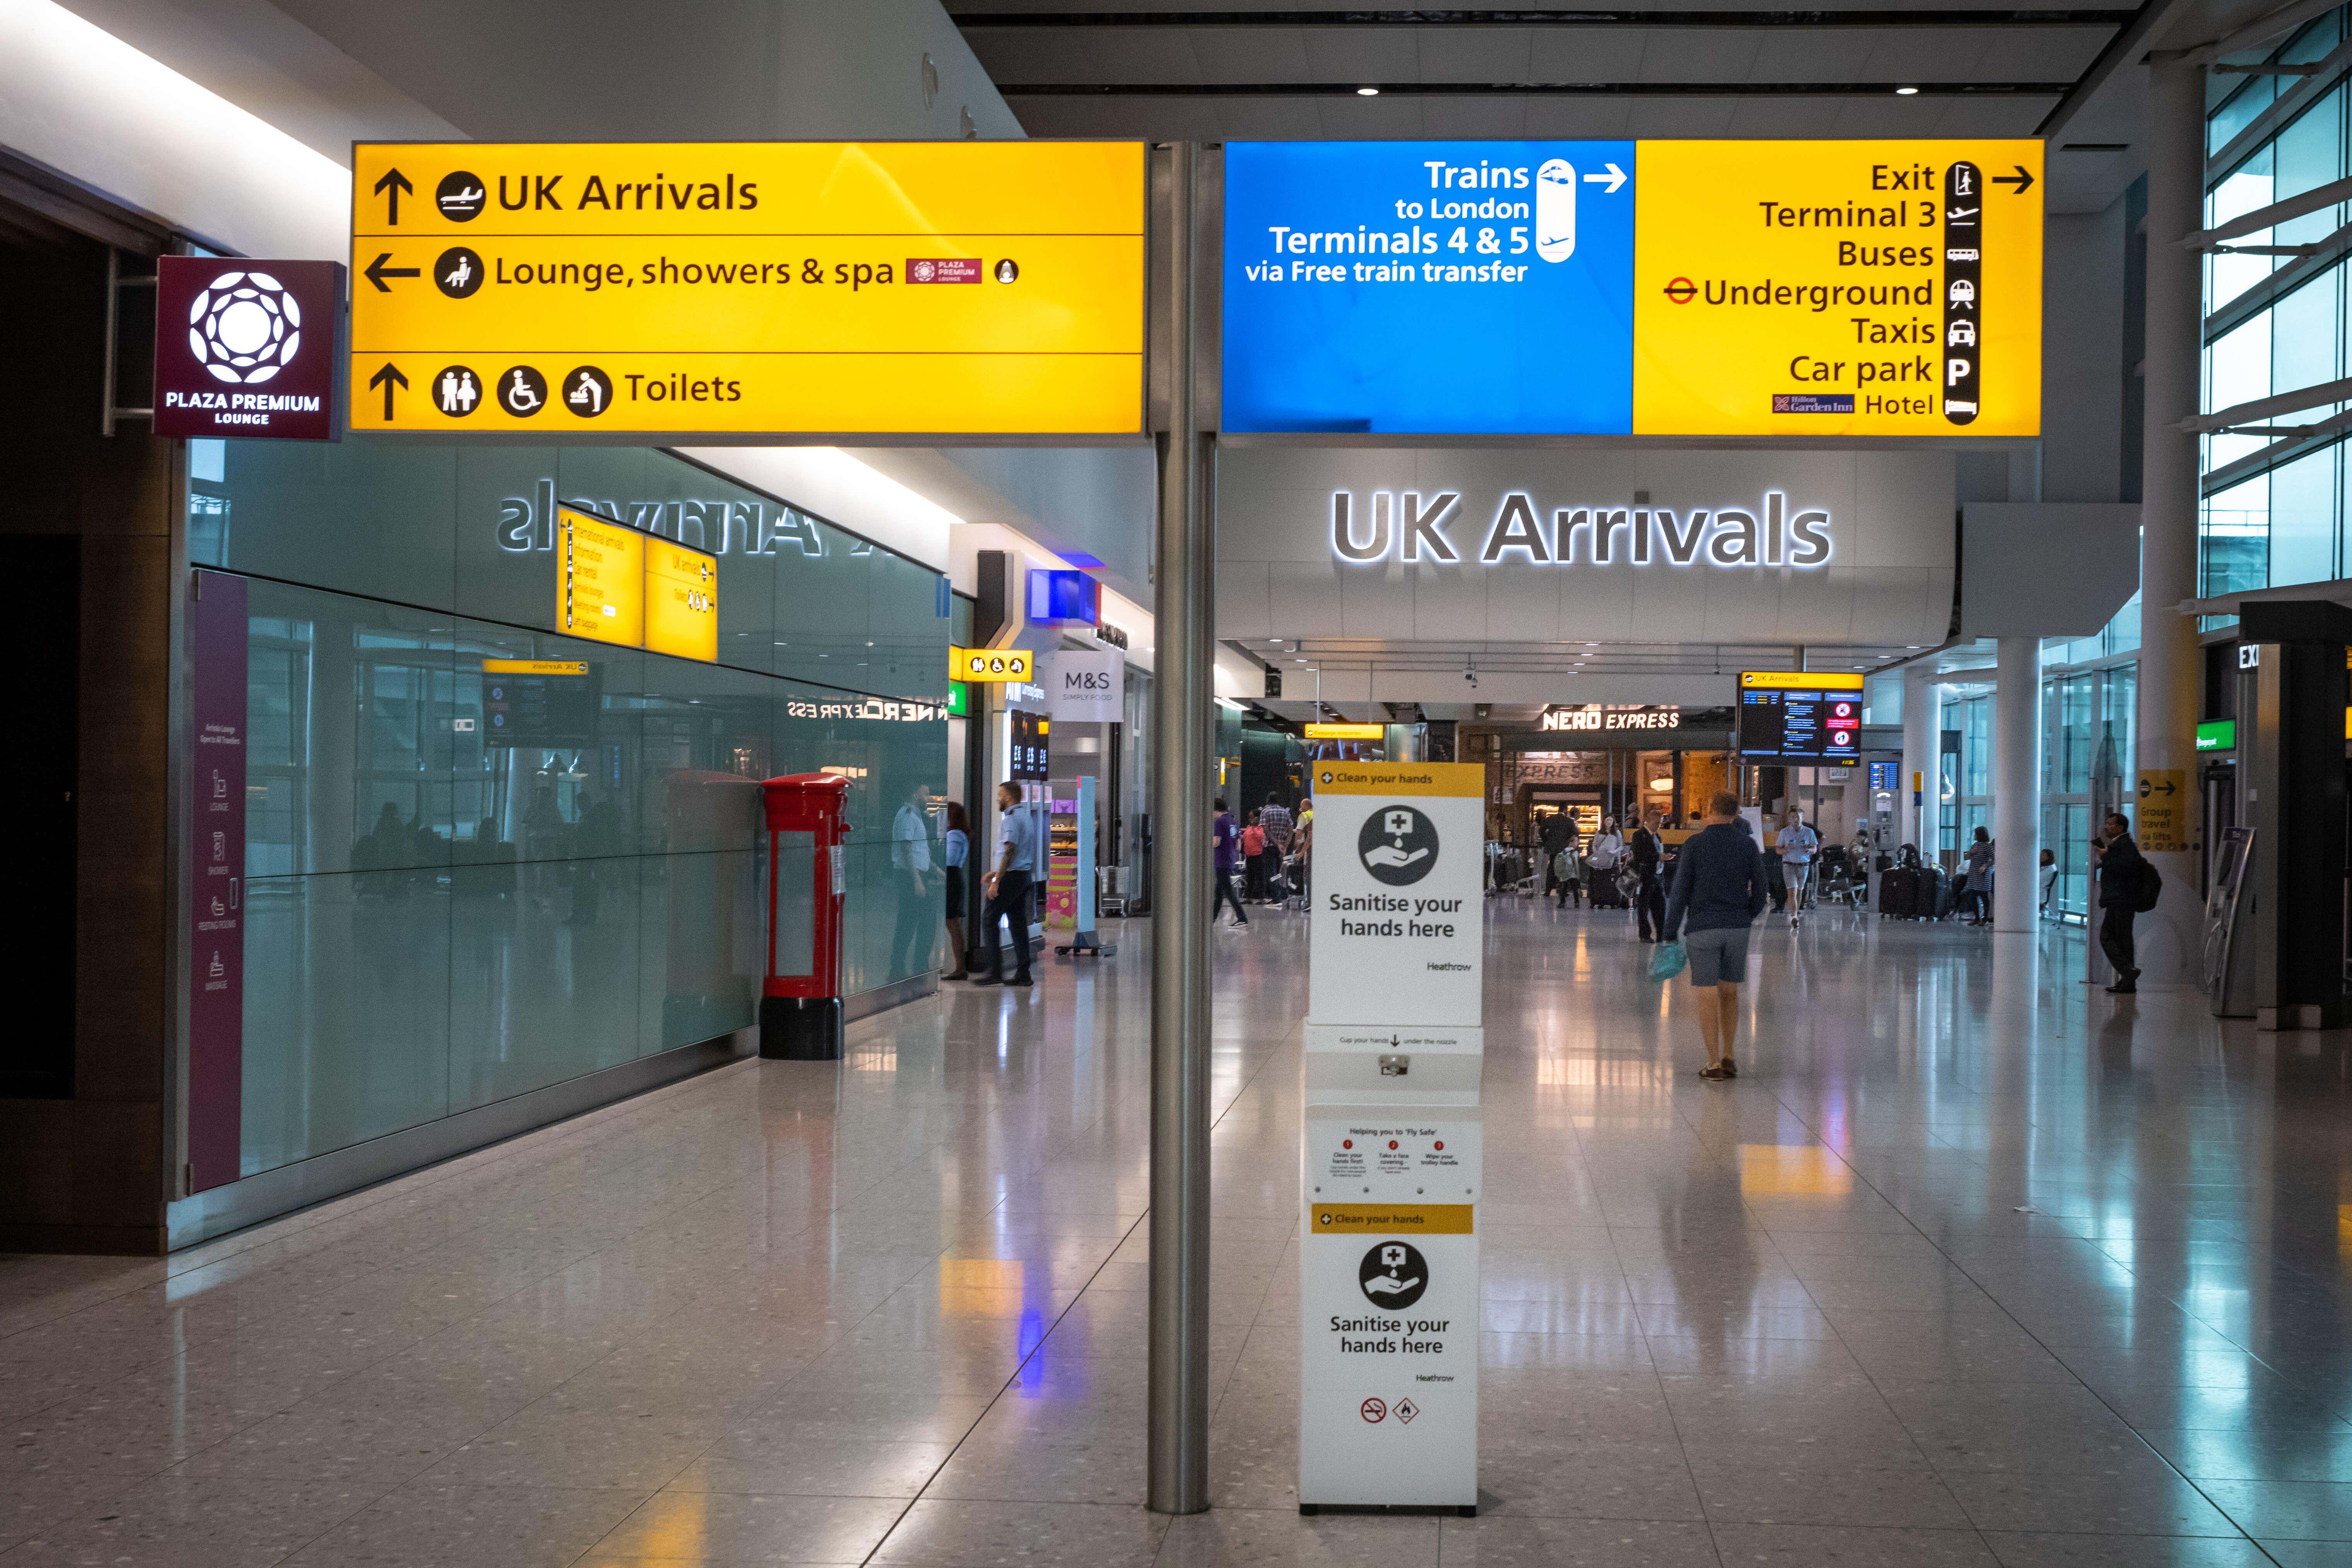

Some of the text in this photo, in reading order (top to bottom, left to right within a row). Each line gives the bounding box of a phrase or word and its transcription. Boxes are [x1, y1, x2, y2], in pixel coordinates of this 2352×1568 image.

[1424, 160, 1529, 189] Trains
[1872, 163, 1935, 191] Exit
[499, 173, 758, 211] UK Arrivals
[1395, 197, 1529, 219] to London
[1759, 200, 1935, 227] Terminal 3
[1269, 225, 1529, 254] Terminals 4 & 5
[1839, 241, 1934, 266] Buses
[497, 256, 893, 292] Lounge, showers & spa
[1245, 260, 1529, 282] via Free train transfer
[1705, 279, 1932, 313] Underground
[1851, 316, 1935, 344] Taxis
[1790, 355, 1932, 389] Car park
[624, 373, 741, 401] Toilets
[166, 392, 319, 412] PLAZA PREMIUM
[1791, 403, 1853, 412] Garden Inn
[1866, 394, 1933, 415] Hotel
[215, 413, 269, 425] LOUNGE
[1331, 489, 1834, 567] UK Arrivals
[1065, 671, 1110, 689] M&S
[1542, 711, 1679, 731] NERO EXPRESS
[1337, 774, 1432, 785] Clean your hands
[1329, 893, 1462, 916] Sanitise your
[1341, 919, 1455, 937] hands here
[1426, 962, 1472, 972] Heathrow
[1335, 1214, 1424, 1225] Clean your hands
[1331, 1316, 1450, 1336] Sanitise your
[1341, 1337, 1443, 1353] hands here
[1416, 1374, 1454, 1382] Heathrow
